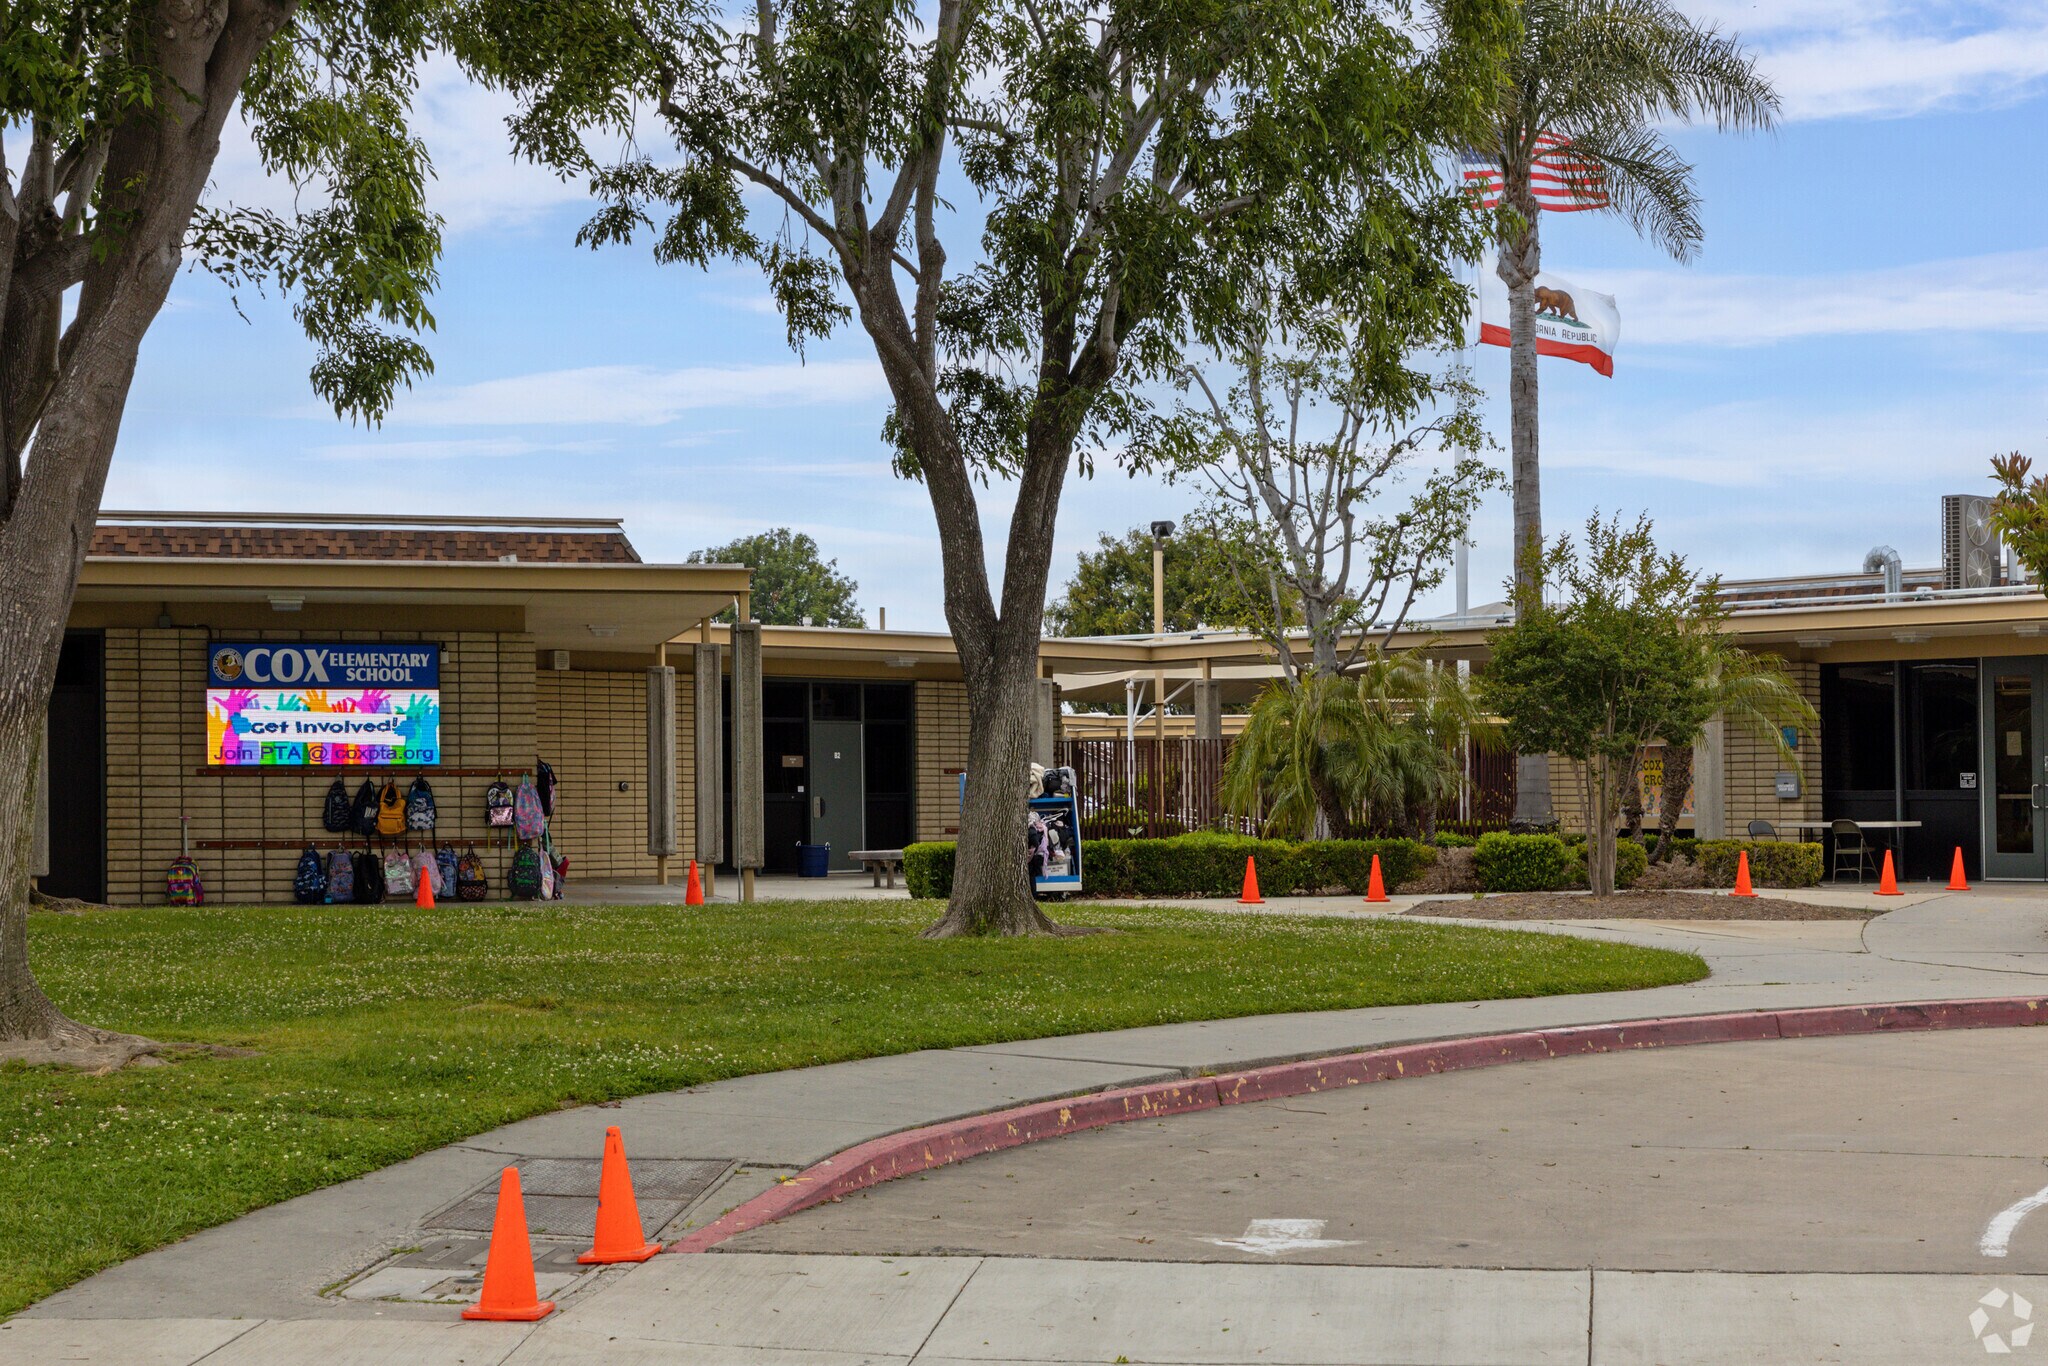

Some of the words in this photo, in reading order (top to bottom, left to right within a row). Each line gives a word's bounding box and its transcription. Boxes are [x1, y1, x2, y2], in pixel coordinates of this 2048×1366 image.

[1562, 328, 1598, 343] REPUBLIC
[244, 648, 330, 683] COX
[330, 653, 430, 668] ELEMENTARY
[346, 667, 414, 682] SCHOOL
[250, 721, 289, 734] Get
[296, 717, 399, 734] Involved!
[214, 746, 253, 760] Join
[260, 746, 300, 760] PTA
[308, 746, 329, 762] @
[335, 746, 434, 762] coxpta.org
[1643, 760, 1661, 771] COX
